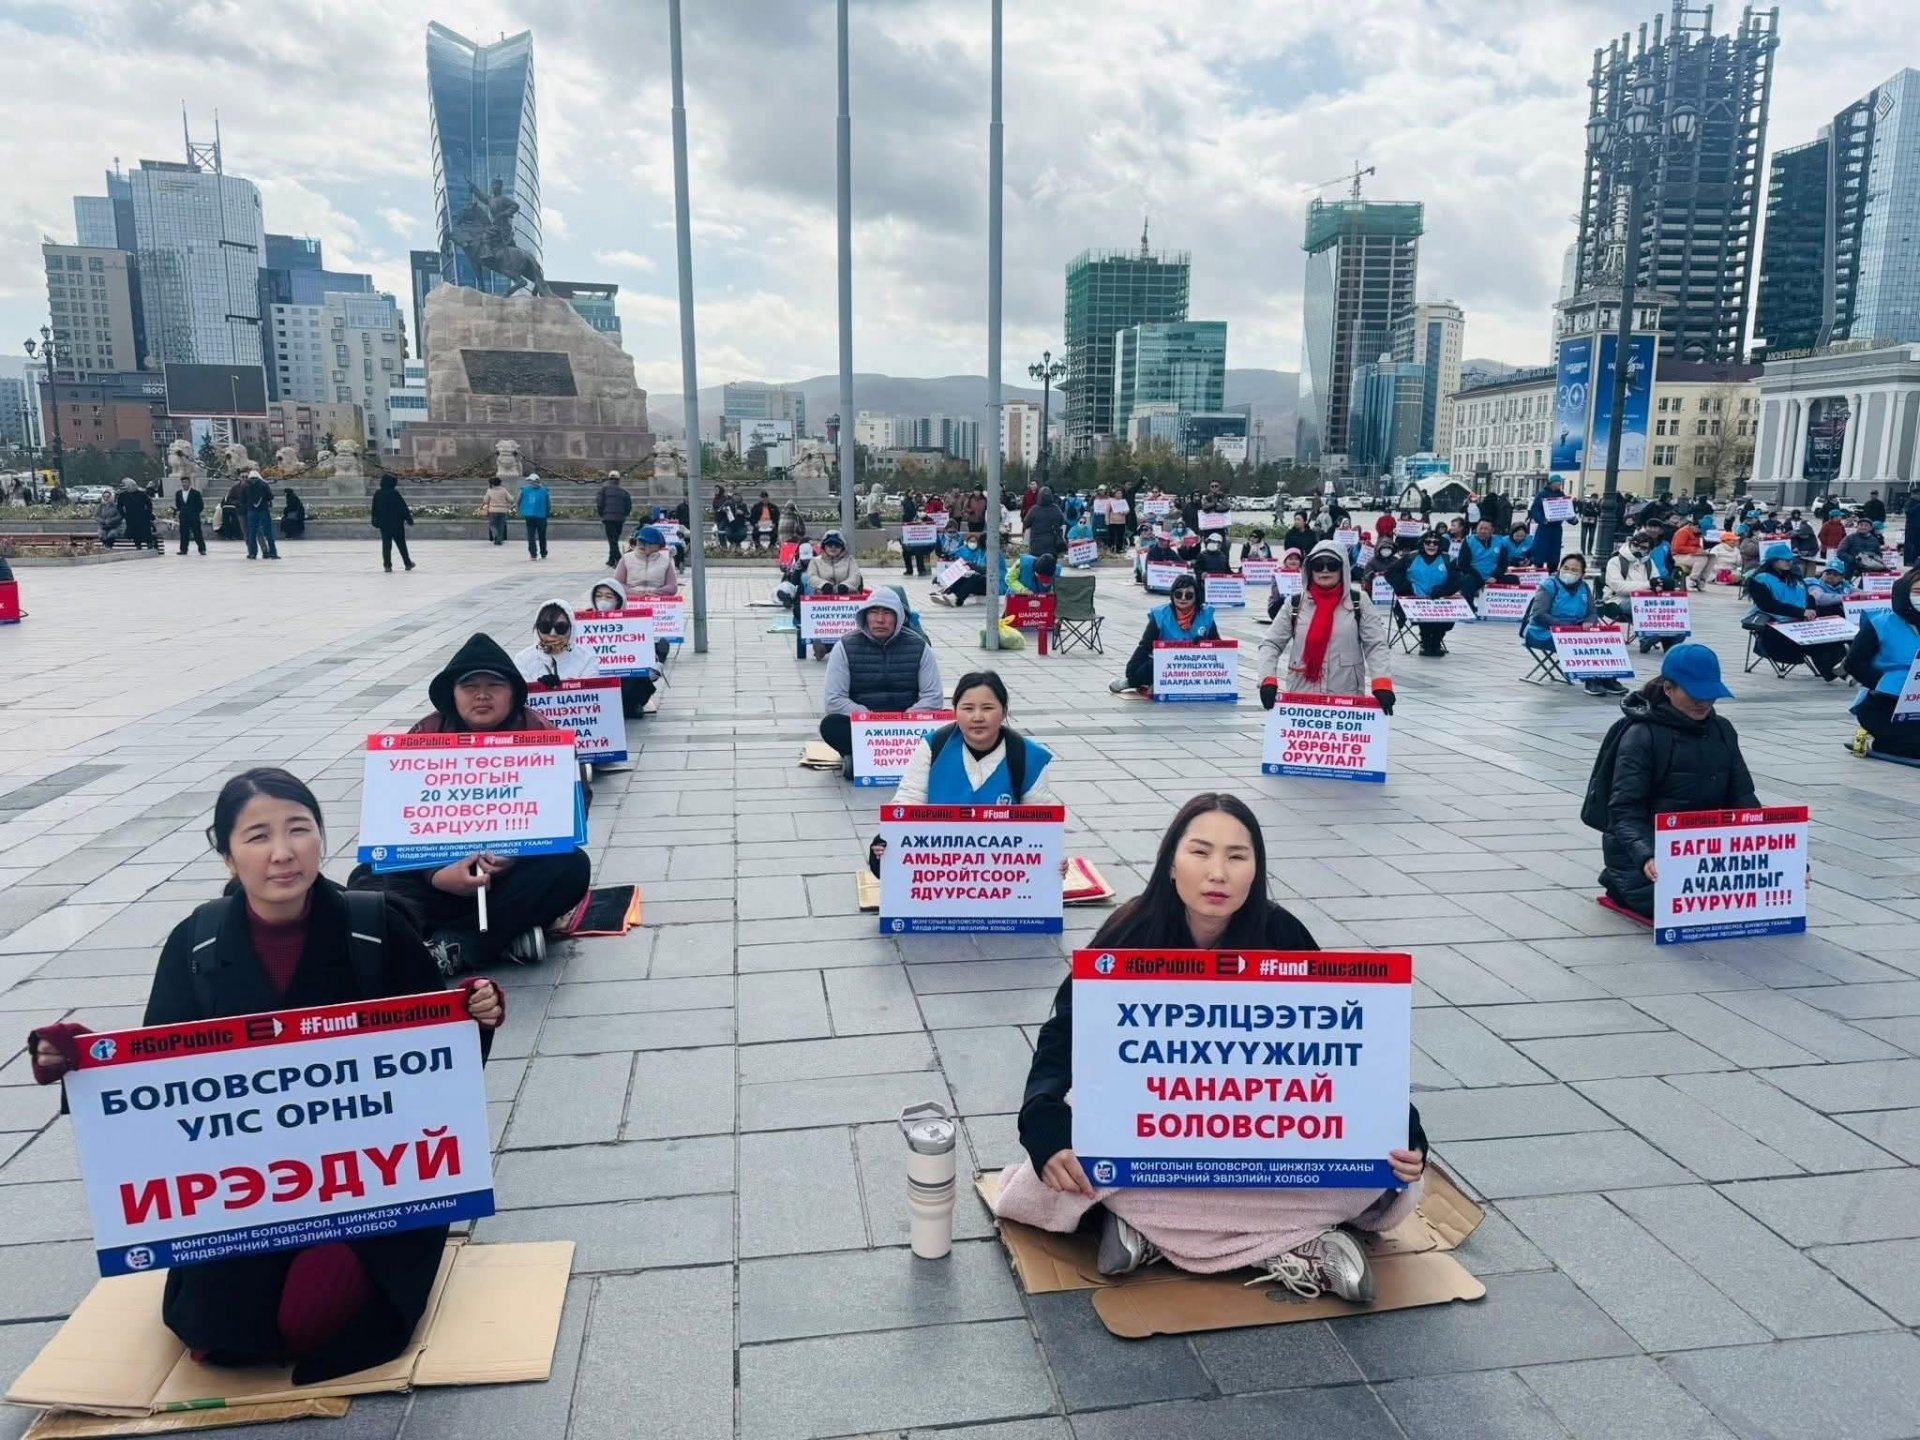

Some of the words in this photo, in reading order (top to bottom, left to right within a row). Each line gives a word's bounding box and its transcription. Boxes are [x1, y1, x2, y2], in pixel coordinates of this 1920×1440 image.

[584, 624, 623, 633] ХҮНЭЭ
[593, 645, 616, 654] УЛС
[596, 655, 635, 664] ЖИНӨ
[526, 697, 552, 706] ДАГ
[557, 694, 599, 705] ЦАЛИН
[538, 704, 600, 717] ЭЛЦЭХГҮЙ
[1280, 707, 1375, 721] БОЛОВСРОЛЫН
[552, 717, 597, 727] РАЛЫН
[1291, 719, 1332, 729] ТӨСӨВ
[1336, 722, 1362, 731] БОЛ
[400, 736, 450, 747] #GoPublic
[484, 735, 561, 745] #FundEducation
[1280, 729, 1336, 740] ЗАРЛАГА
[1342, 733, 1371, 743] БИШ
[874, 747, 915, 756] ДОРОЙ
[1288, 740, 1362, 754] ХӨРӨНГӨ
[390, 757, 457, 771] УЛСЫН
[465, 754, 554, 769] ТӨСВИЙН
[1283, 752, 1365, 767] ОРУУЛАЛТ
[425, 772, 519, 785] ОРЛОГЫН
[421, 790, 441, 801] 20
[447, 786, 522, 801] ХУВИЙГ
[403, 802, 538, 819] БОЛОВСРОЛД
[410, 819, 498, 835] ЗАРЦУУЛ
[901, 836, 1022, 848] АЖИЛЛАСААР
[1671, 838, 1721, 856] БАГШ
[1730, 834, 1795, 852] НАРЫН
[903, 853, 985, 866] АМЬДРАЛ
[992, 853, 1041, 865] УЛАМ
[1698, 854, 1768, 873] АЖЛЫН
[913, 868, 1030, 884] ДОРОЙТСООР,
[1682, 872, 1783, 894] АЧААЛЛЫГ
[911, 888, 1011, 900] ЯДУУРСААР
[1673, 893, 1756, 913] БУУРУУЛ
[1125, 958, 1205, 974] #GoPublic
[1260, 958, 1388, 977] #FundEducation
[1117, 1001, 1363, 1031] ХҮРЭЛЦЭЭТЭЙ
[130, 1027, 233, 1057] #GoPublic
[300, 1002, 451, 1036] #FundEducation
[1118, 1040, 1362, 1067] САНХҮҮЖИЛТ
[101, 1059, 359, 1116] БОЛОВСРОЛ
[374, 1047, 453, 1079] БОЛ
[1147, 1073, 1332, 1102] ЧАНАРТАЙ
[178, 1108, 263, 1142] УЛС
[277, 1091, 393, 1129] ОРНЫ
[1137, 1114, 1343, 1139] БОЛОВСРОЛ
[1131, 1162, 1193, 1171] МОНГОЛЫН
[1196, 1162, 1266, 1172] БОЛОВСРОЛ,
[1269, 1162, 1325, 1172] ШИНЖЛЭХ
[1328, 1163, 1374, 1172] УХААНЫ
[119, 1125, 462, 1225] ИРЭЭДҮЙ
[1131, 1172, 1210, 1183] ҮЙЛДВЭРЧНИЙ
[1213, 1172, 1272, 1183] ЭВЛЭЛИЙН
[1274, 1174, 1319, 1183] ХОЛБОО
[171, 1233, 248, 1251] МОНГОЛЫН
[252, 1221, 335, 1242] БОЛОВСРОЛ,
[338, 1208, 402, 1226] ШИНЖЛЭХ
[405, 1198, 457, 1215] УХААНЫ
[273, 1227, 342, 1248] ЭВЛЭЛИЙН
[346, 1219, 397, 1237] ХОЛБОО
